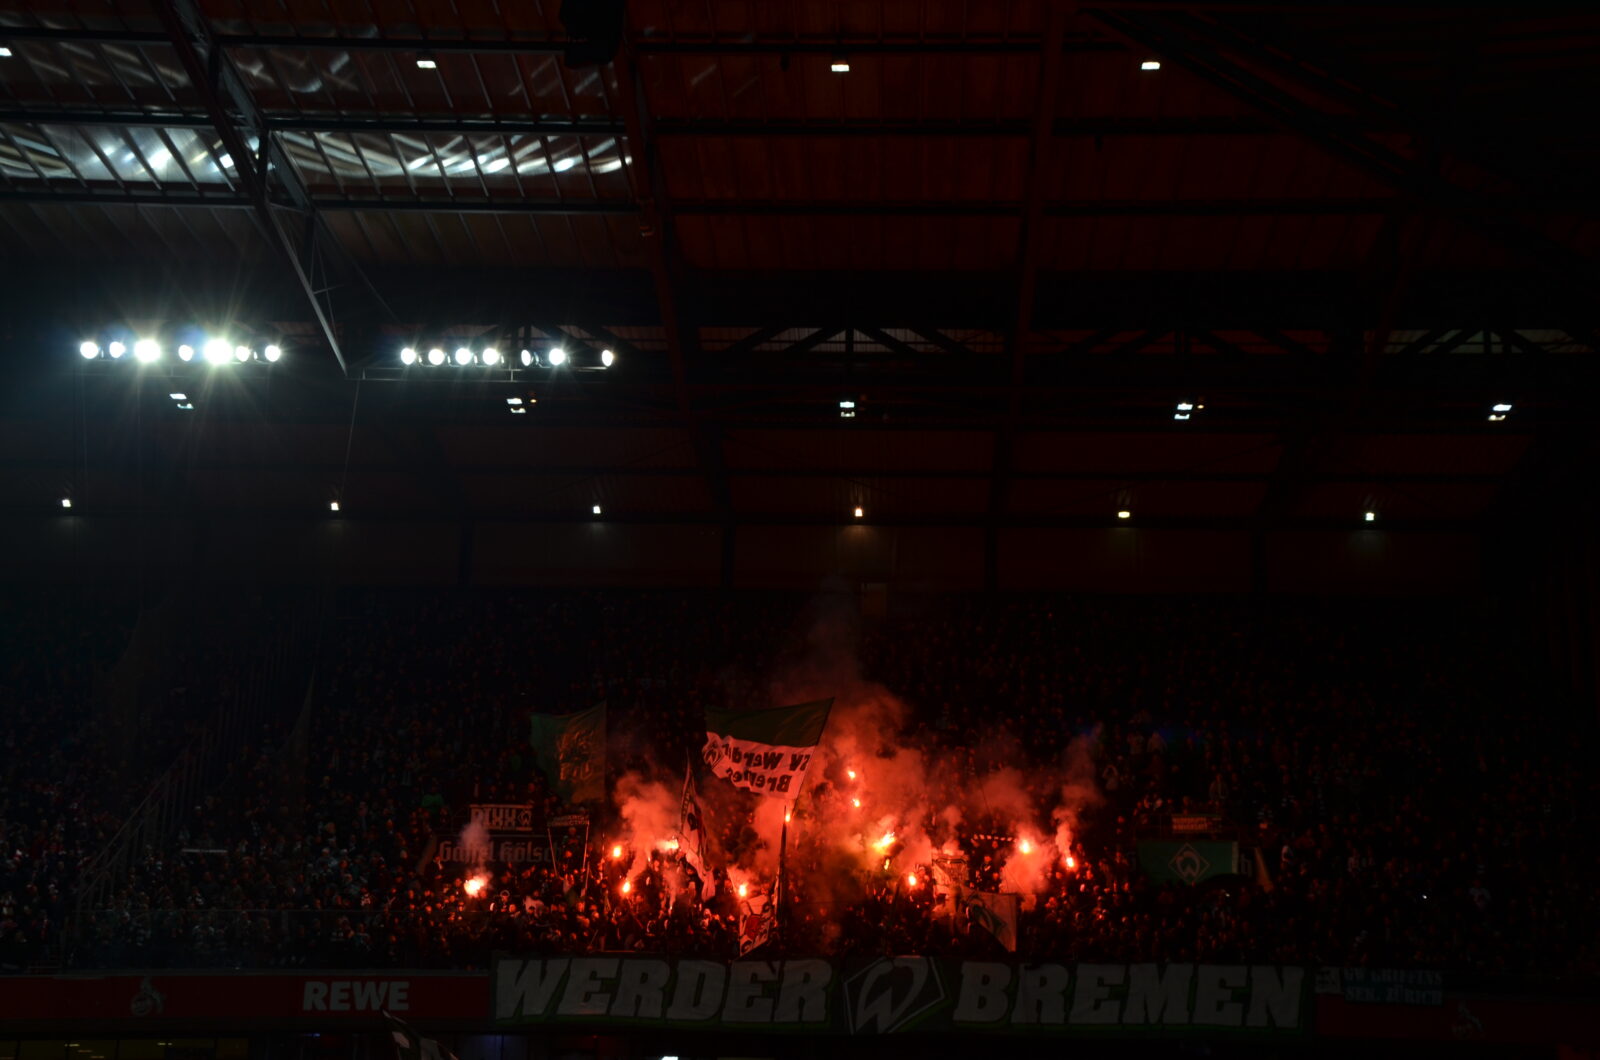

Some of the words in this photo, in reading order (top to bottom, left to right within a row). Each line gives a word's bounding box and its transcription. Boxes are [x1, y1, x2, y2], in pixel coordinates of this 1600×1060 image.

[302, 980, 410, 1011] REWE
[495, 957, 833, 1022] WERDER
[952, 961, 1304, 1028] BREMEN
